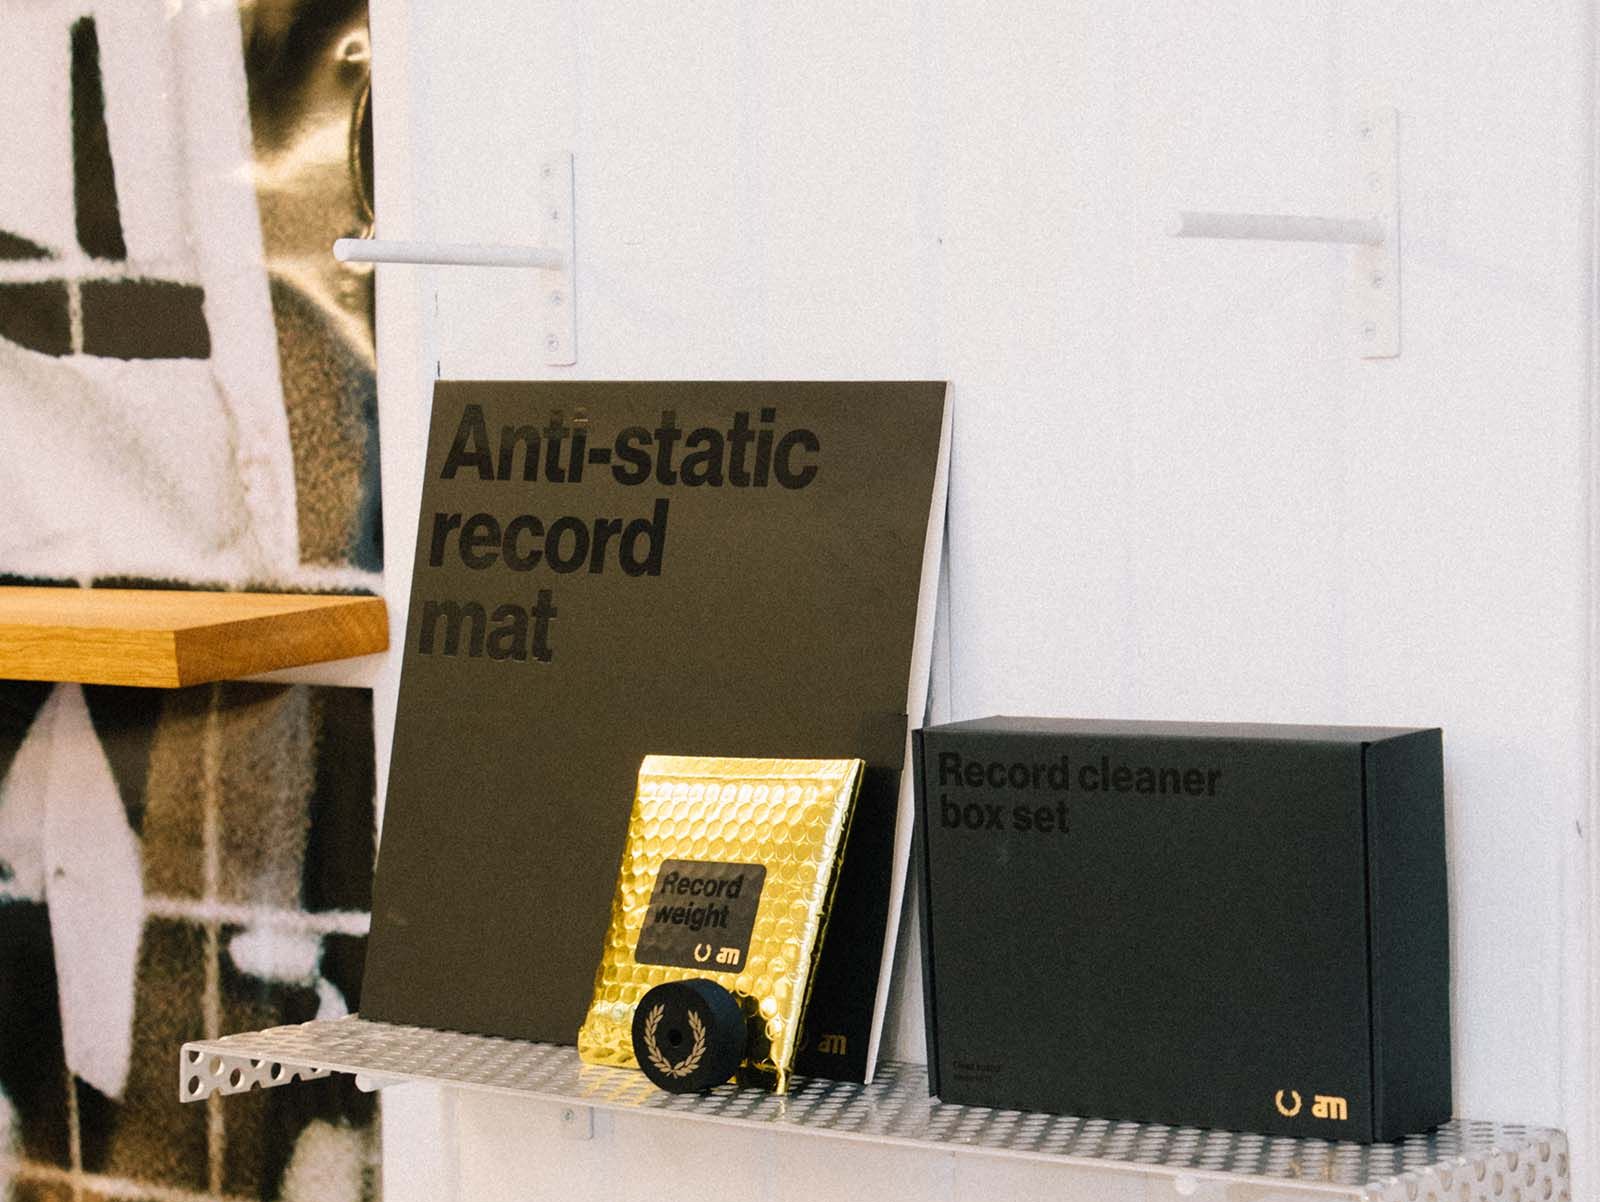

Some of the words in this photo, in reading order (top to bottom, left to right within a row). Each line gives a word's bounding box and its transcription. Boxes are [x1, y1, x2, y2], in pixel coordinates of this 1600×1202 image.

[439, 403, 821, 490] Anti-static
[428, 498, 670, 577] record
[417, 588, 558, 665] mat
[938, 751, 1070, 791] Record
[1078, 755, 1222, 797] cleaner
[940, 793, 1005, 830] box
[1012, 799, 1070, 834] set
[660, 870, 744, 900] Record
[654, 903, 730, 931] weight
[1310, 1093, 1348, 1121] am
